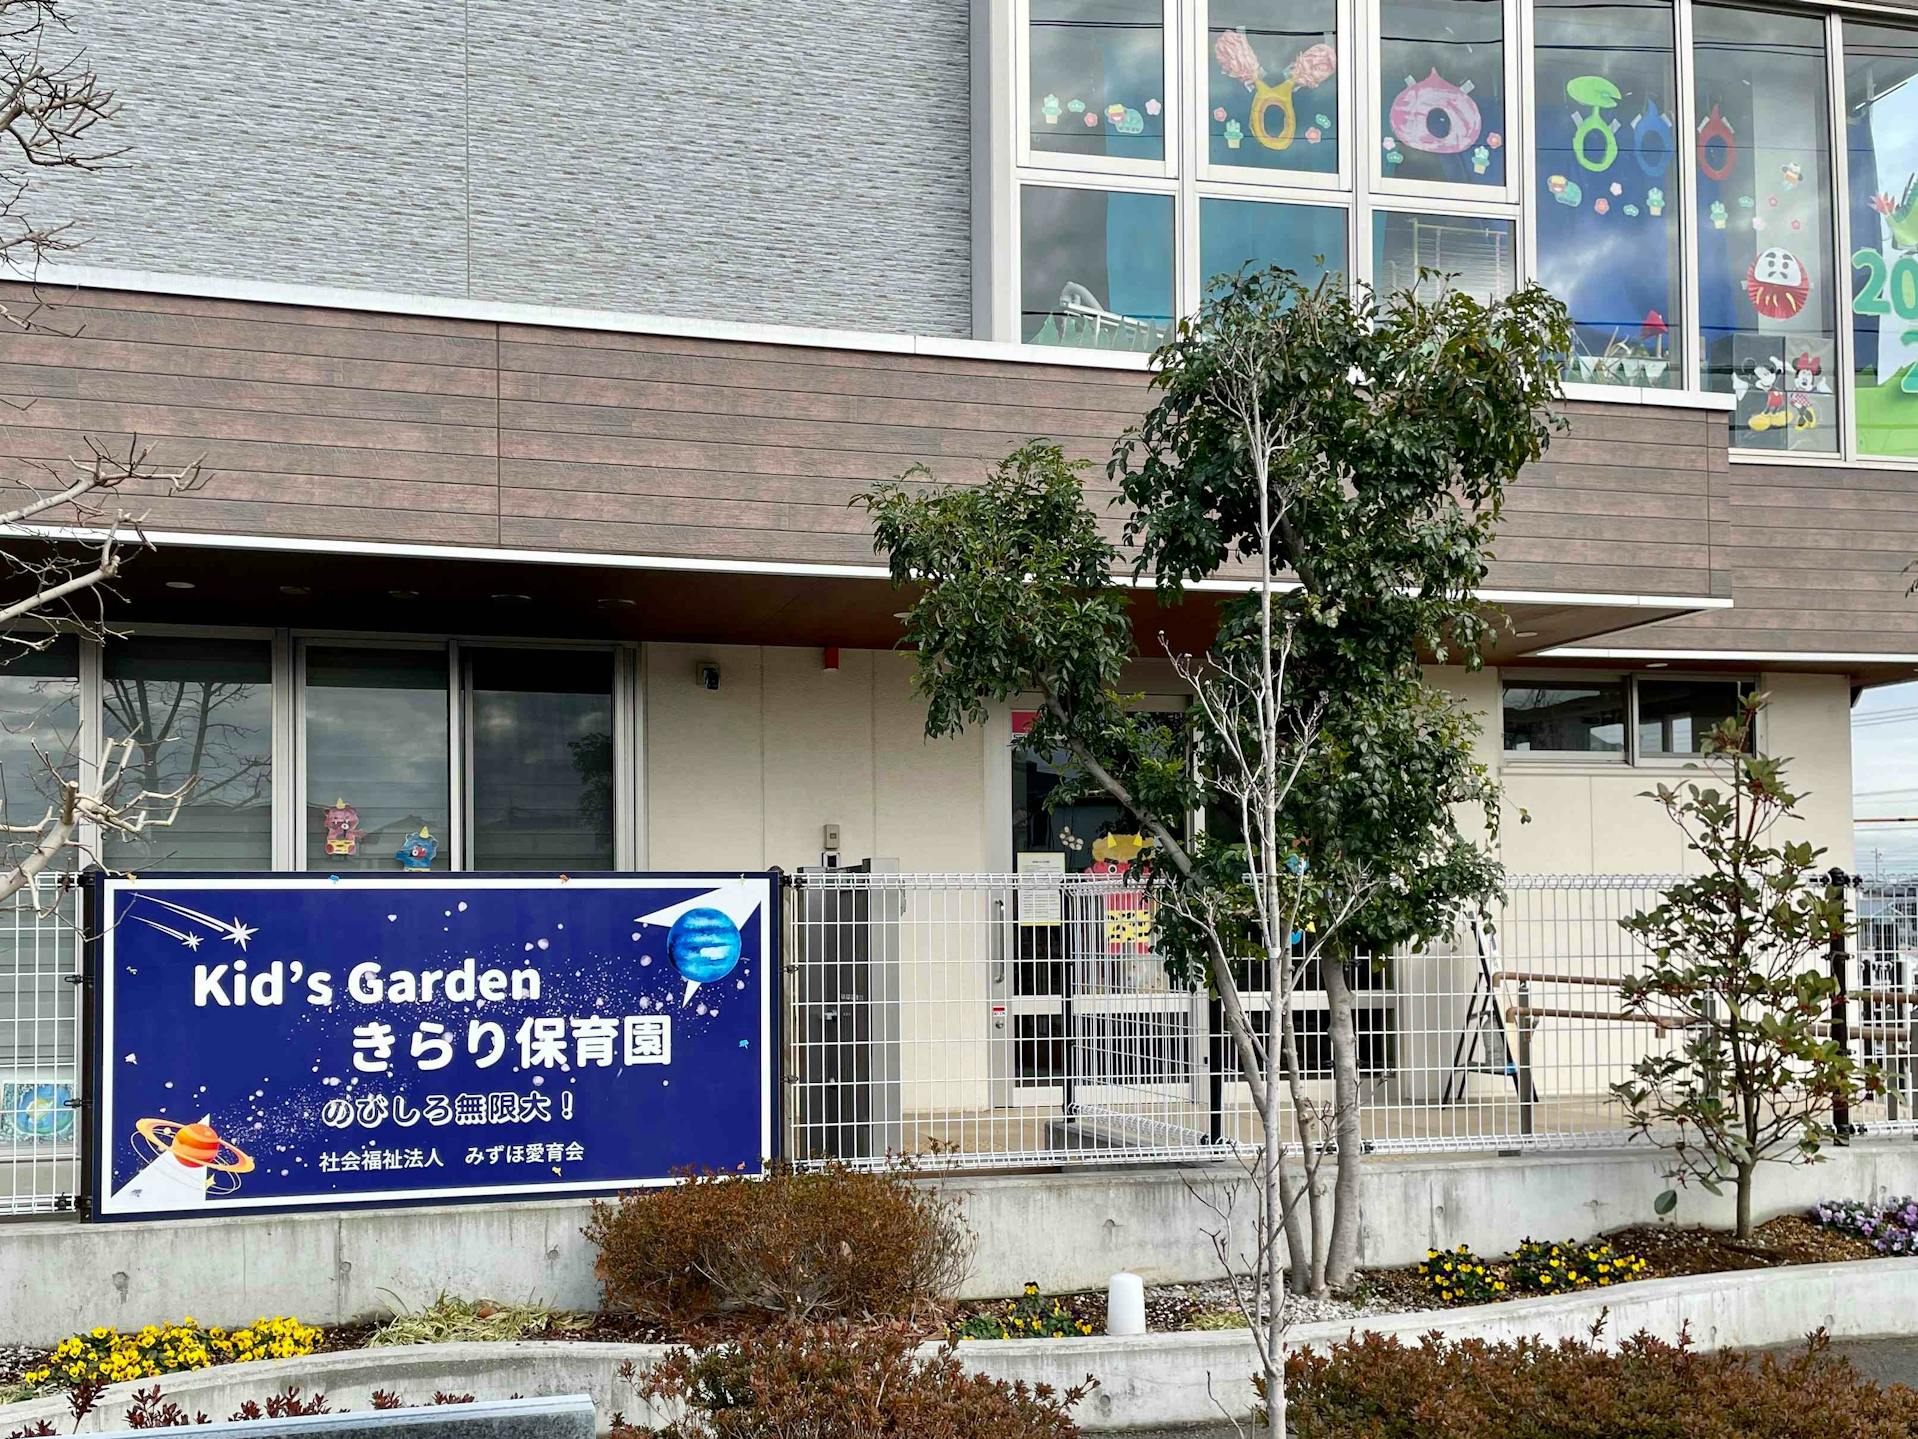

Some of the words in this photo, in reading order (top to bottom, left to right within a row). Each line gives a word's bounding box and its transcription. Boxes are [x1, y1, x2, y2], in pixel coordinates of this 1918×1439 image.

[194, 960, 333, 1008] Kid’s
[346, 957, 541, 1005] Garden
[351, 1013, 673, 1073] きらり保育園
[318, 1147, 444, 1173] 社会福祉法人
[465, 1141, 585, 1165] みずほ愛育会
